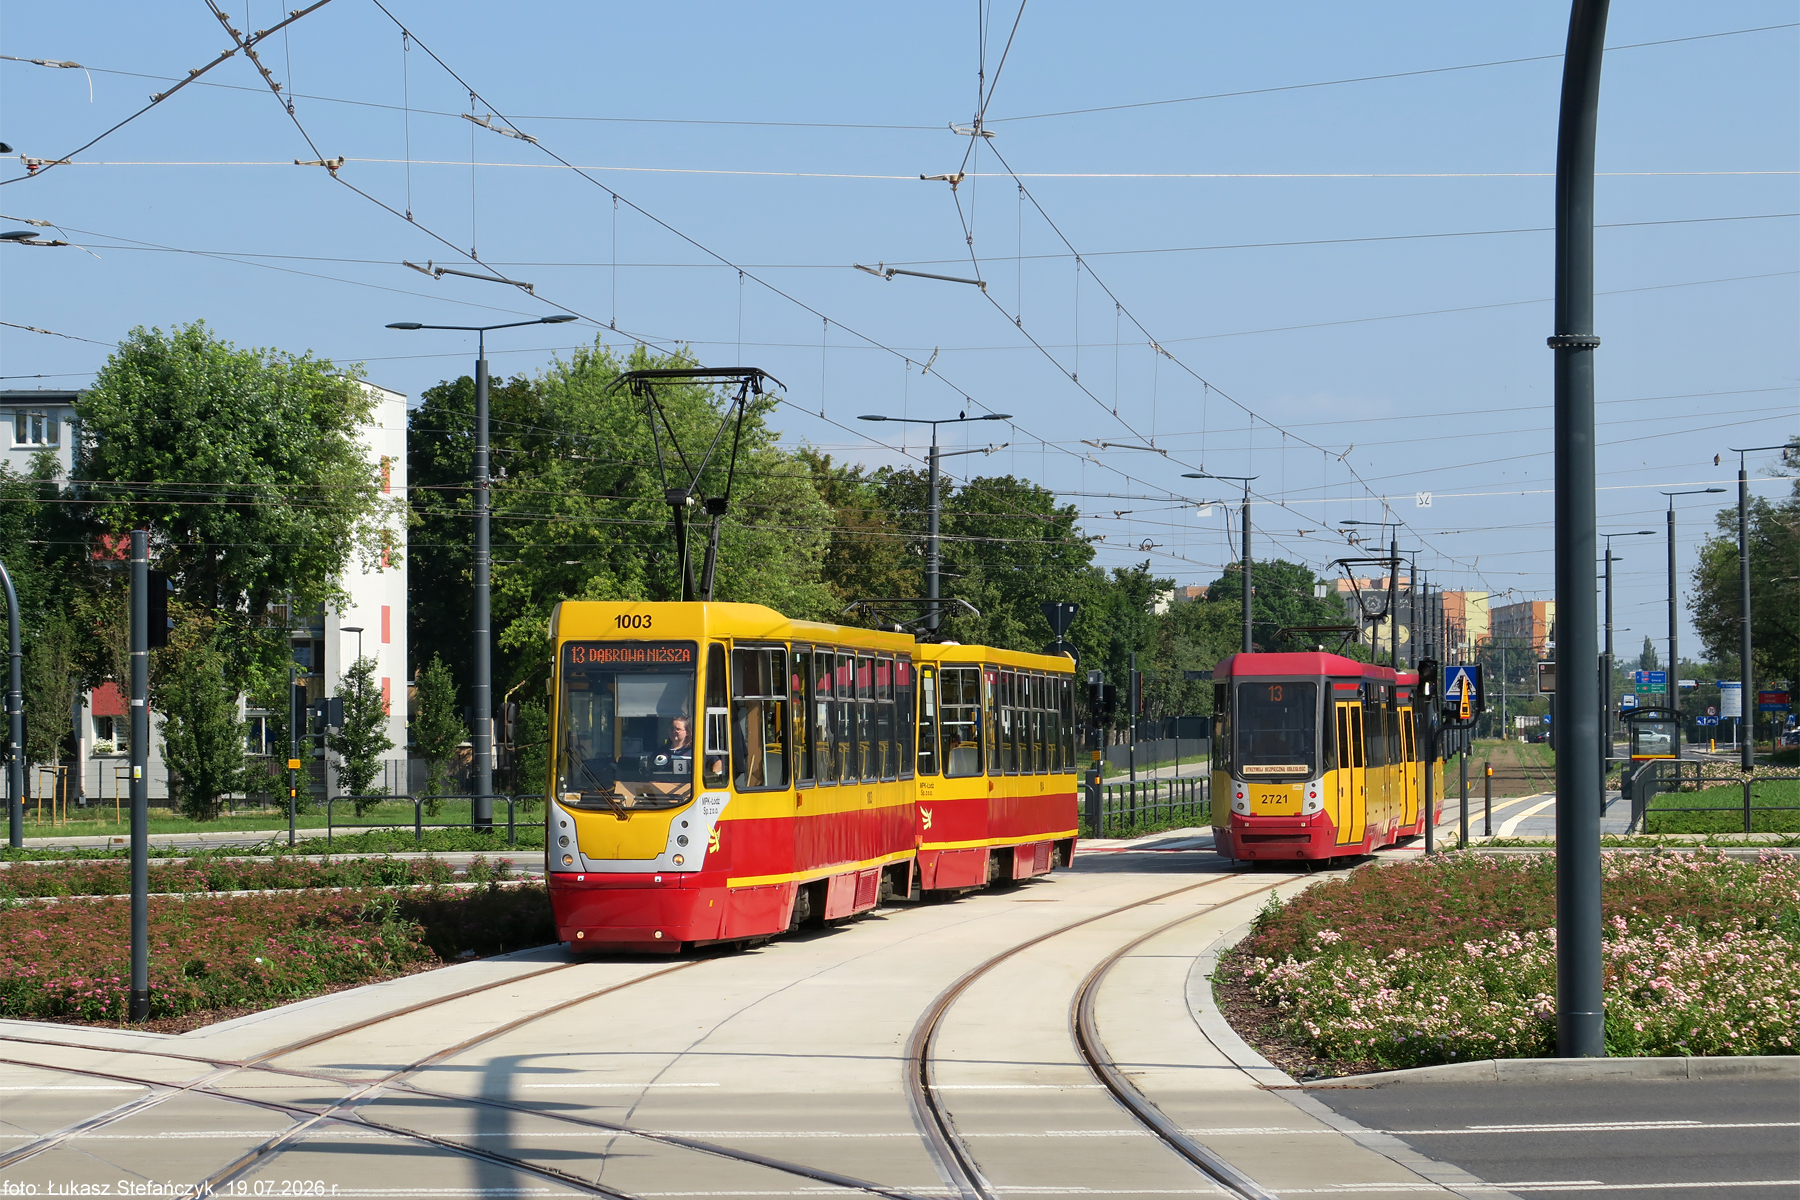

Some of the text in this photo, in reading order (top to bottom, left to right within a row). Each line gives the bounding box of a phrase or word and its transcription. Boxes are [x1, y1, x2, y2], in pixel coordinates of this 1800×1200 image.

[614, 614, 652, 629] 1003
[571, 646, 691, 663] 13 DĄBROWA NIŻSZA
[1268, 685, 1283, 701] 13
[677, 763, 684, 772] 3
[1261, 794, 1288, 804] 2721
